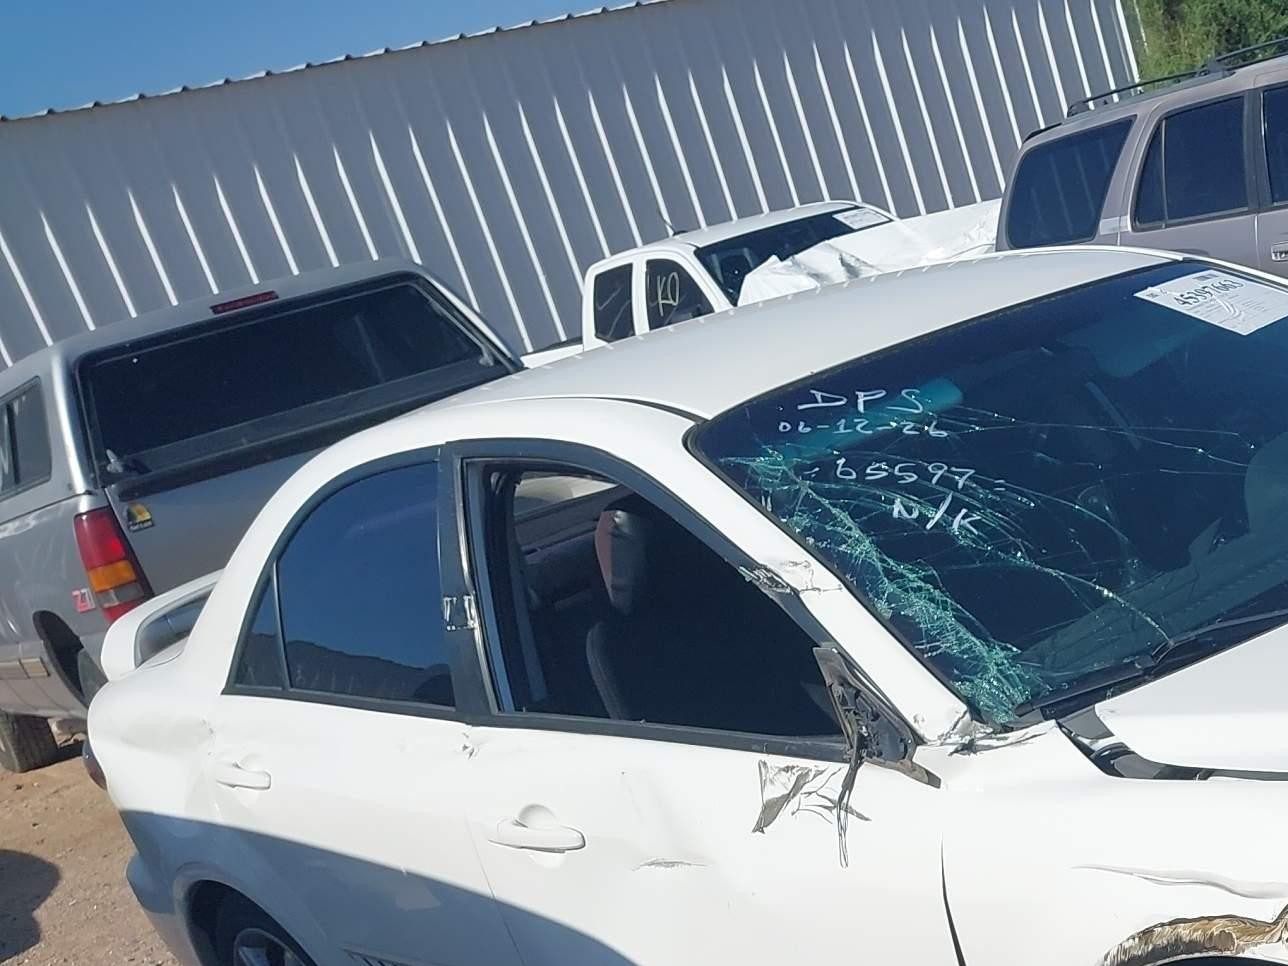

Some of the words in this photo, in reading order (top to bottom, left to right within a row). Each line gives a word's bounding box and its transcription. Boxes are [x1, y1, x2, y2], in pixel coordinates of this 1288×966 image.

[1174, 279, 1245, 306] 45397663
[797, 389, 923, 413] DPS
[778, 418, 949, 437] 06-12-26
[892, 491, 983, 535] N/K
